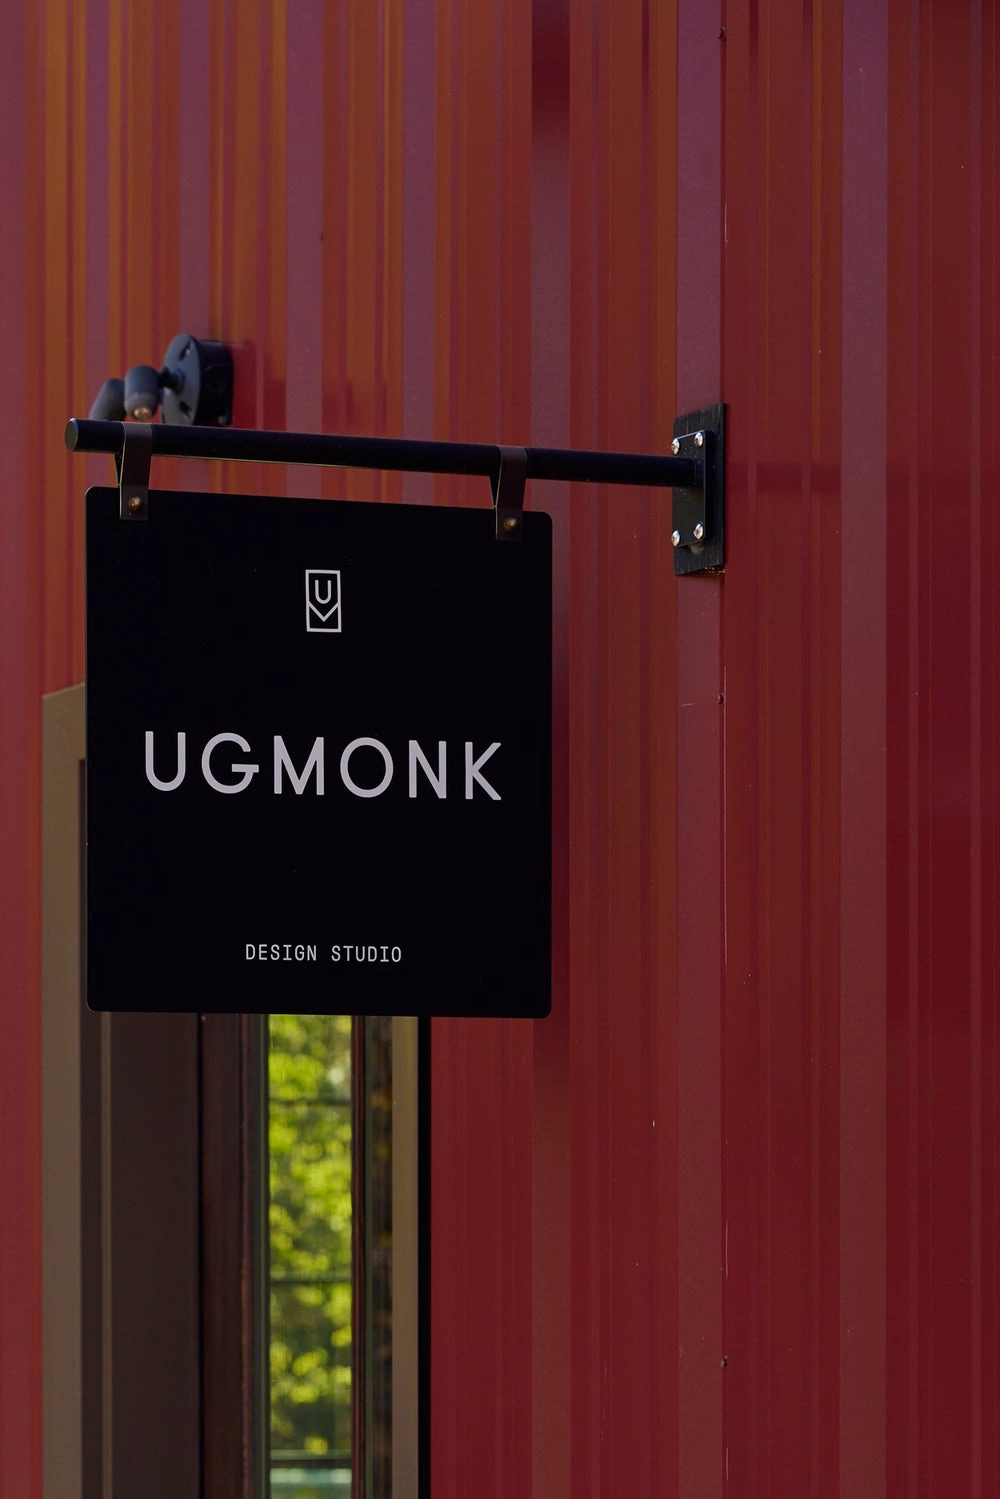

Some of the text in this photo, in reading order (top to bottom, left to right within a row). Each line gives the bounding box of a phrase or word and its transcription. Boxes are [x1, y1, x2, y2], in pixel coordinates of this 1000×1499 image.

[144, 730, 503, 801] UGMONK
[245, 943, 402, 963] DESIGN STUDIO
